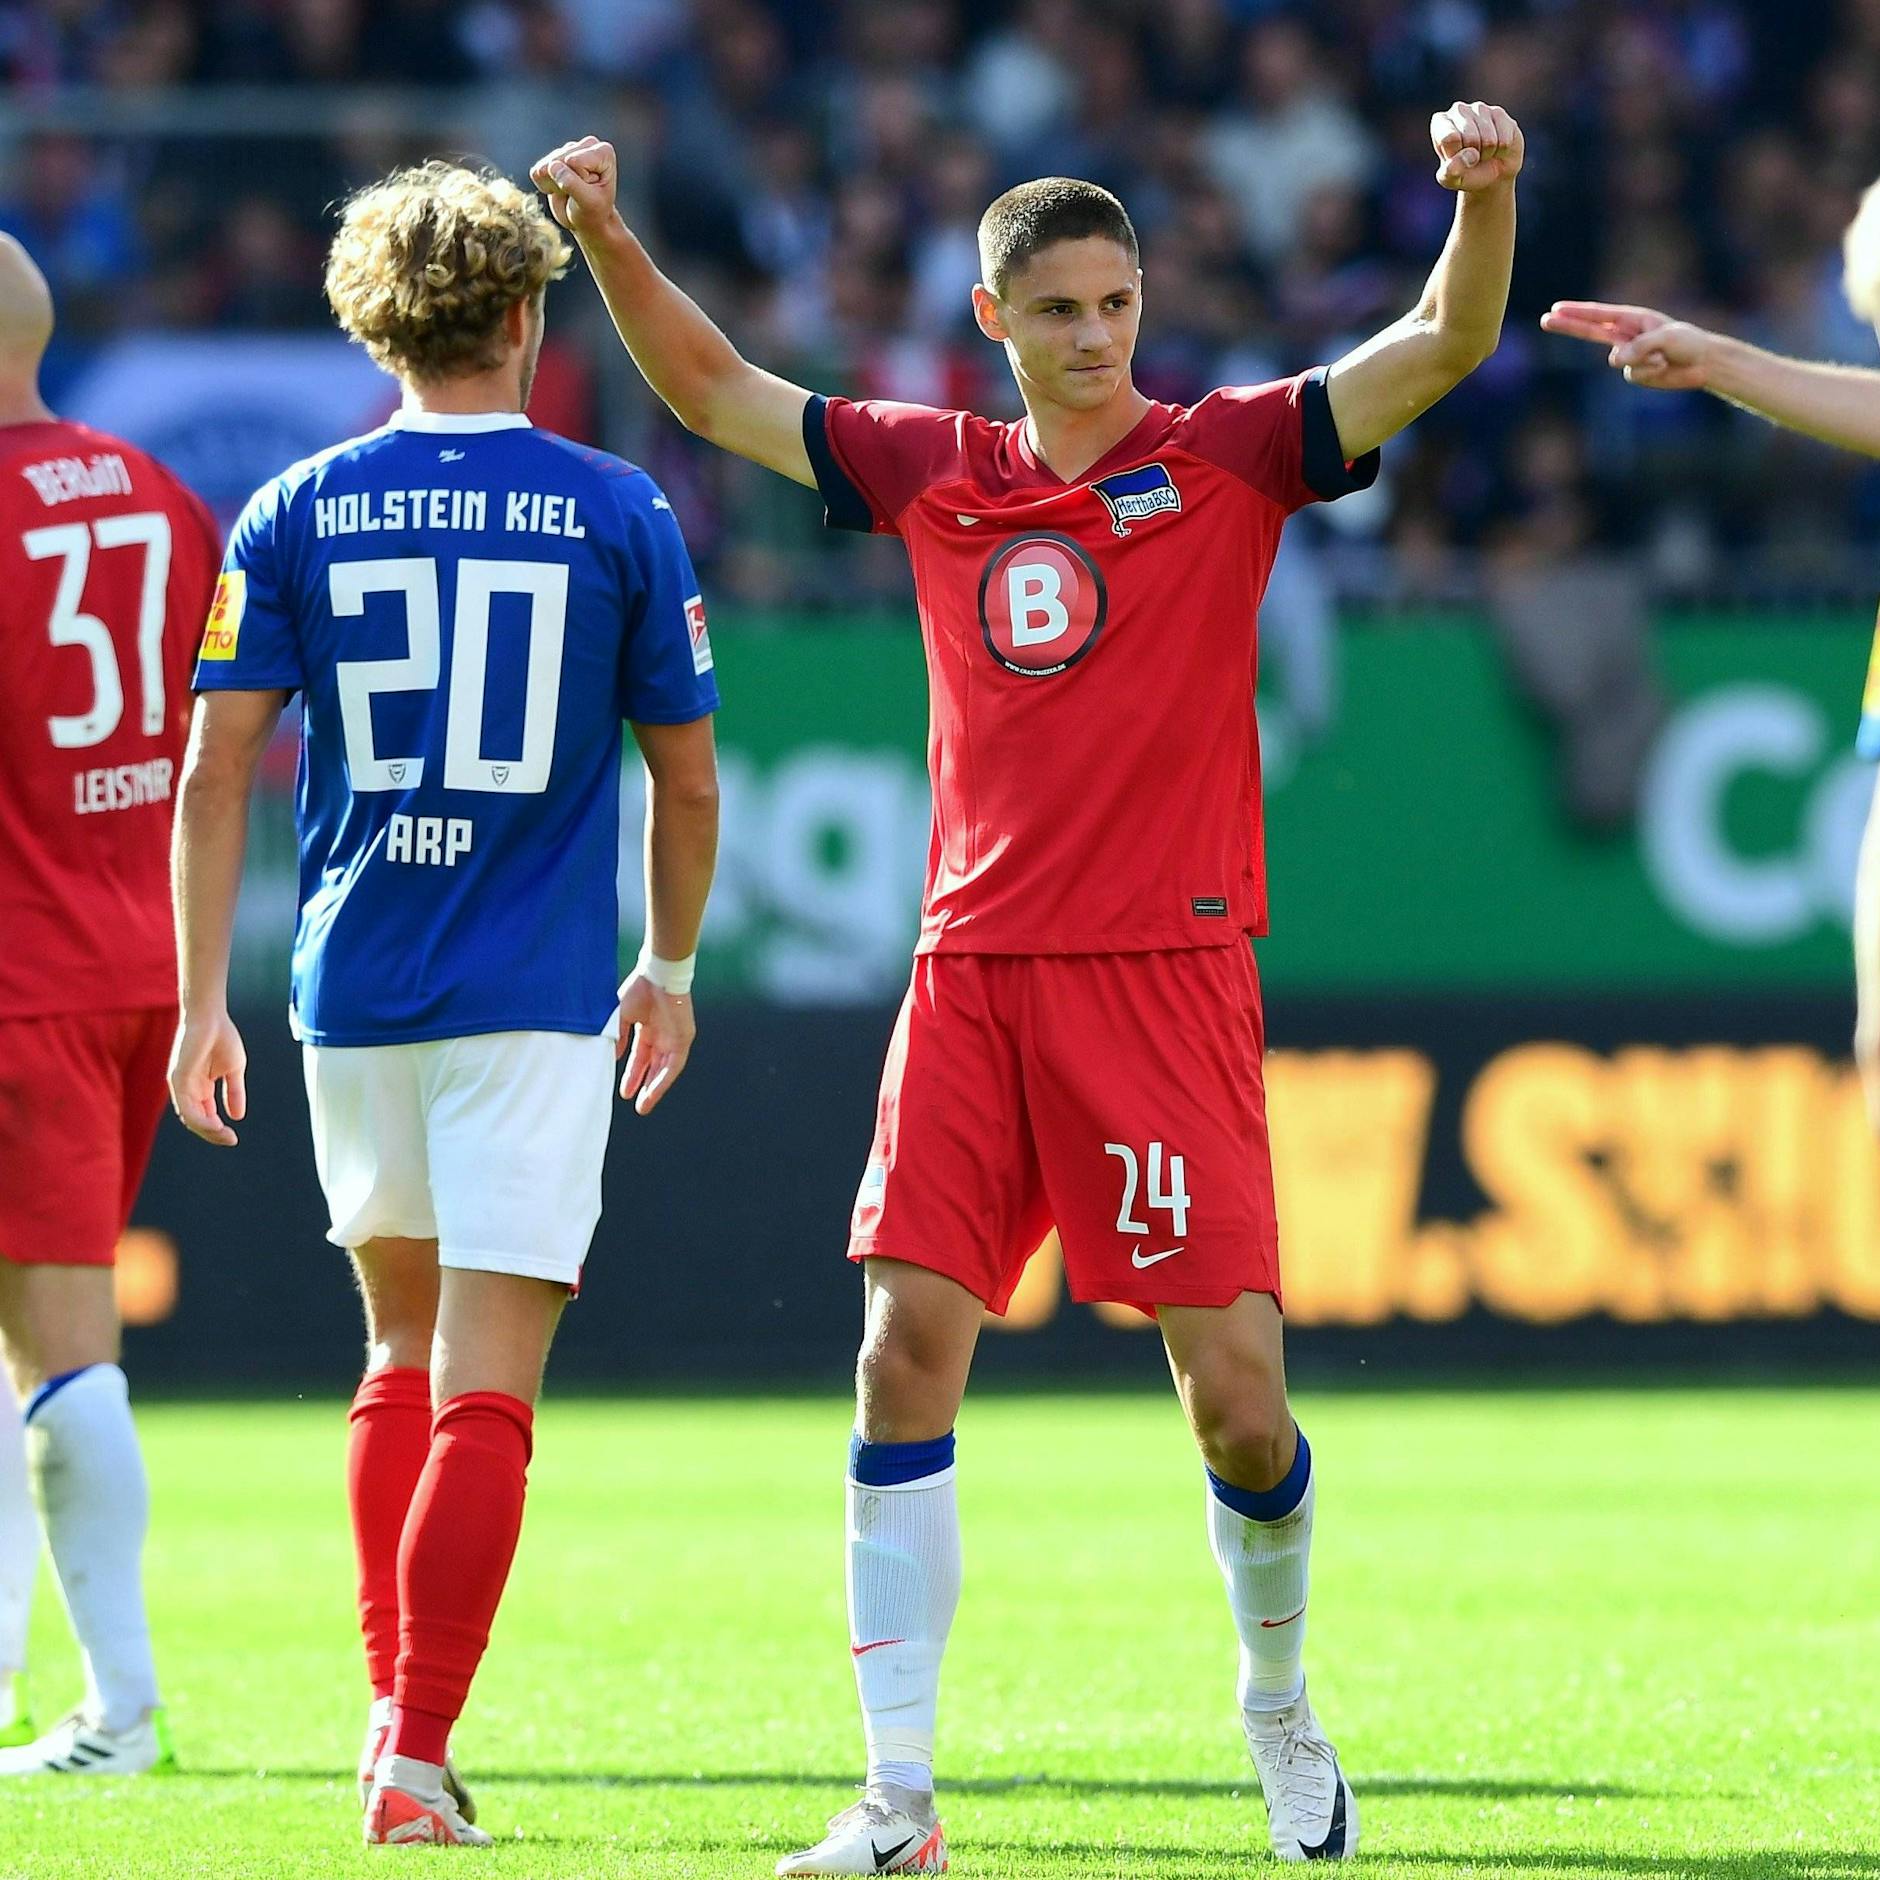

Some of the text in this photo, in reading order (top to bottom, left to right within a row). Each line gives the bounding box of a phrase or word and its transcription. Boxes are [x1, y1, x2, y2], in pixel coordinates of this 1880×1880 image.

[315, 489, 586, 538] HOLSTEIN KIEL
[22, 511, 172, 749] 37
[1008, 563, 1069, 648] B
[329, 557, 569, 794] 20
[386, 813, 473, 867] ARP
[1104, 1141, 1191, 1237] 24
